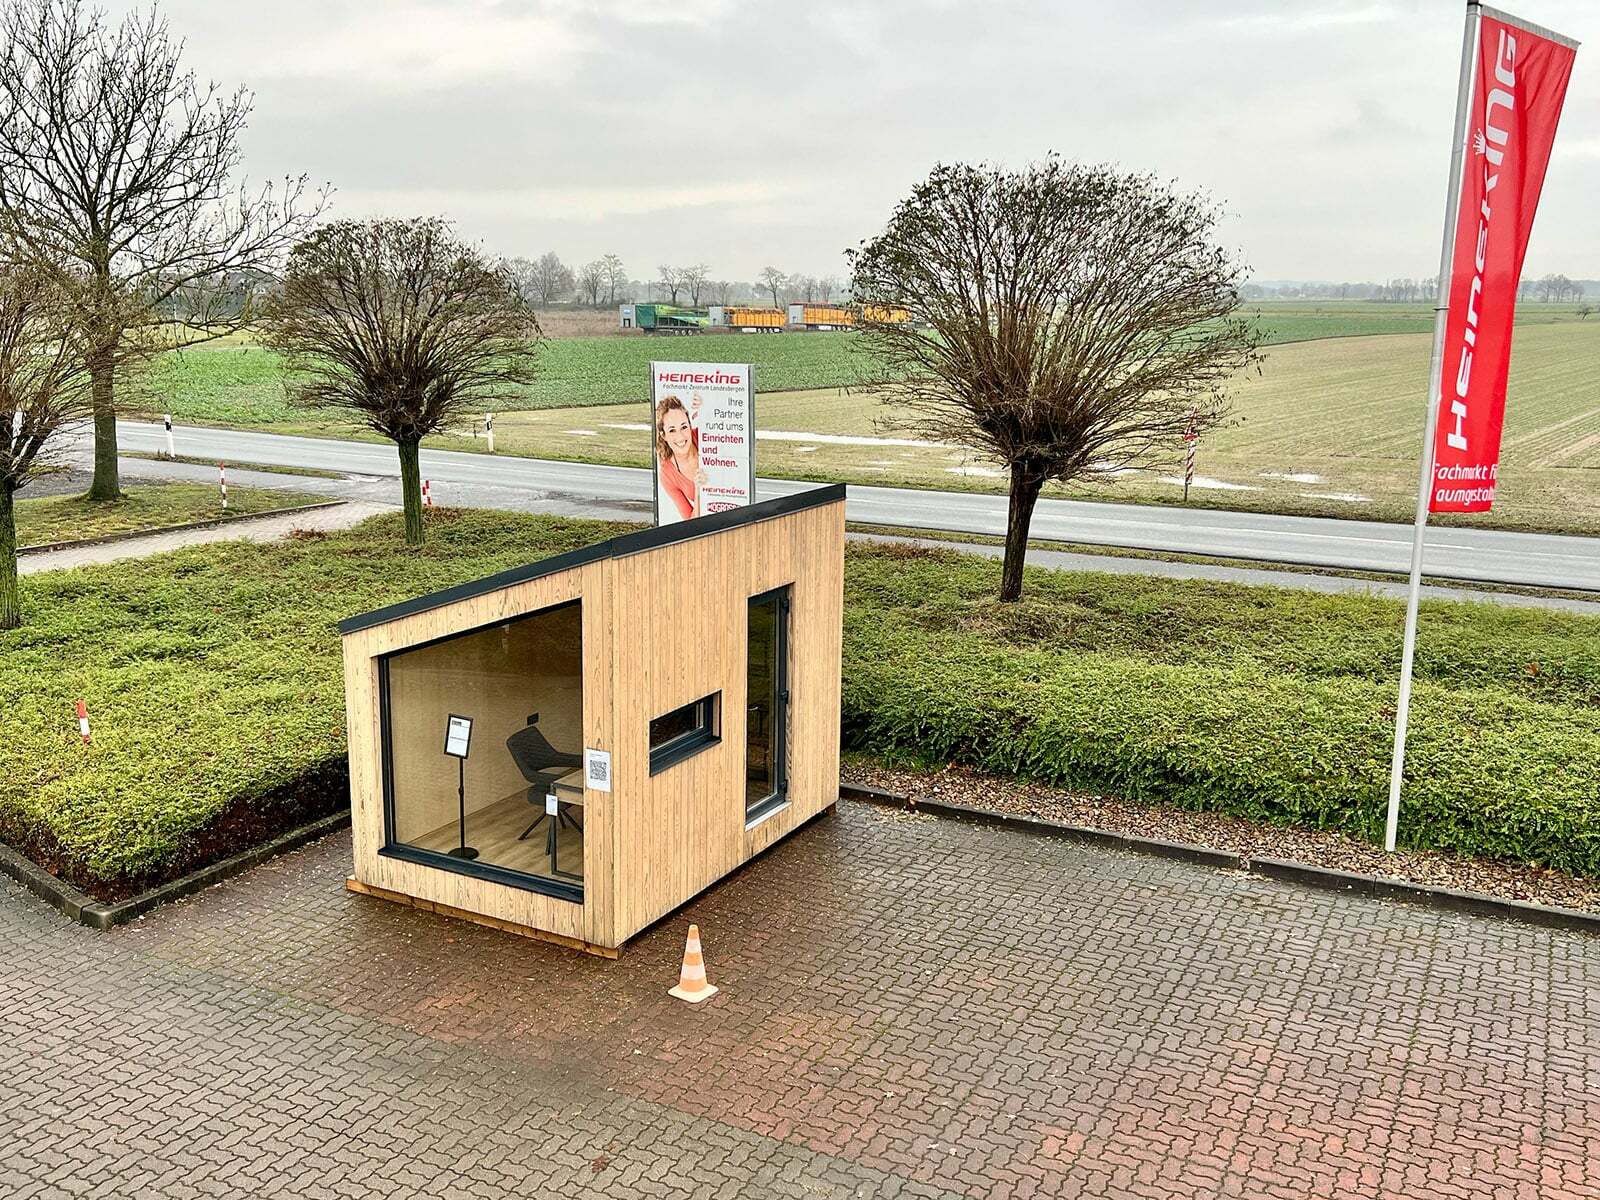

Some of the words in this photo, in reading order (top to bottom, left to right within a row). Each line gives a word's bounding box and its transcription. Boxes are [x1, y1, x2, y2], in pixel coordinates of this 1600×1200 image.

[1447, 28, 1517, 452] HEINEKING
[660, 371, 741, 384] HEINEKING
[728, 398, 744, 407] Ihre
[714, 408, 744, 419] Partner
[705, 422, 724, 431] rund
[726, 423, 744, 431] ums
[702, 433, 744, 444] Einrichten
[702, 446, 718, 455] und
[702, 457, 738, 468] Wohnen.
[702, 487, 745, 495] HEINEKING
